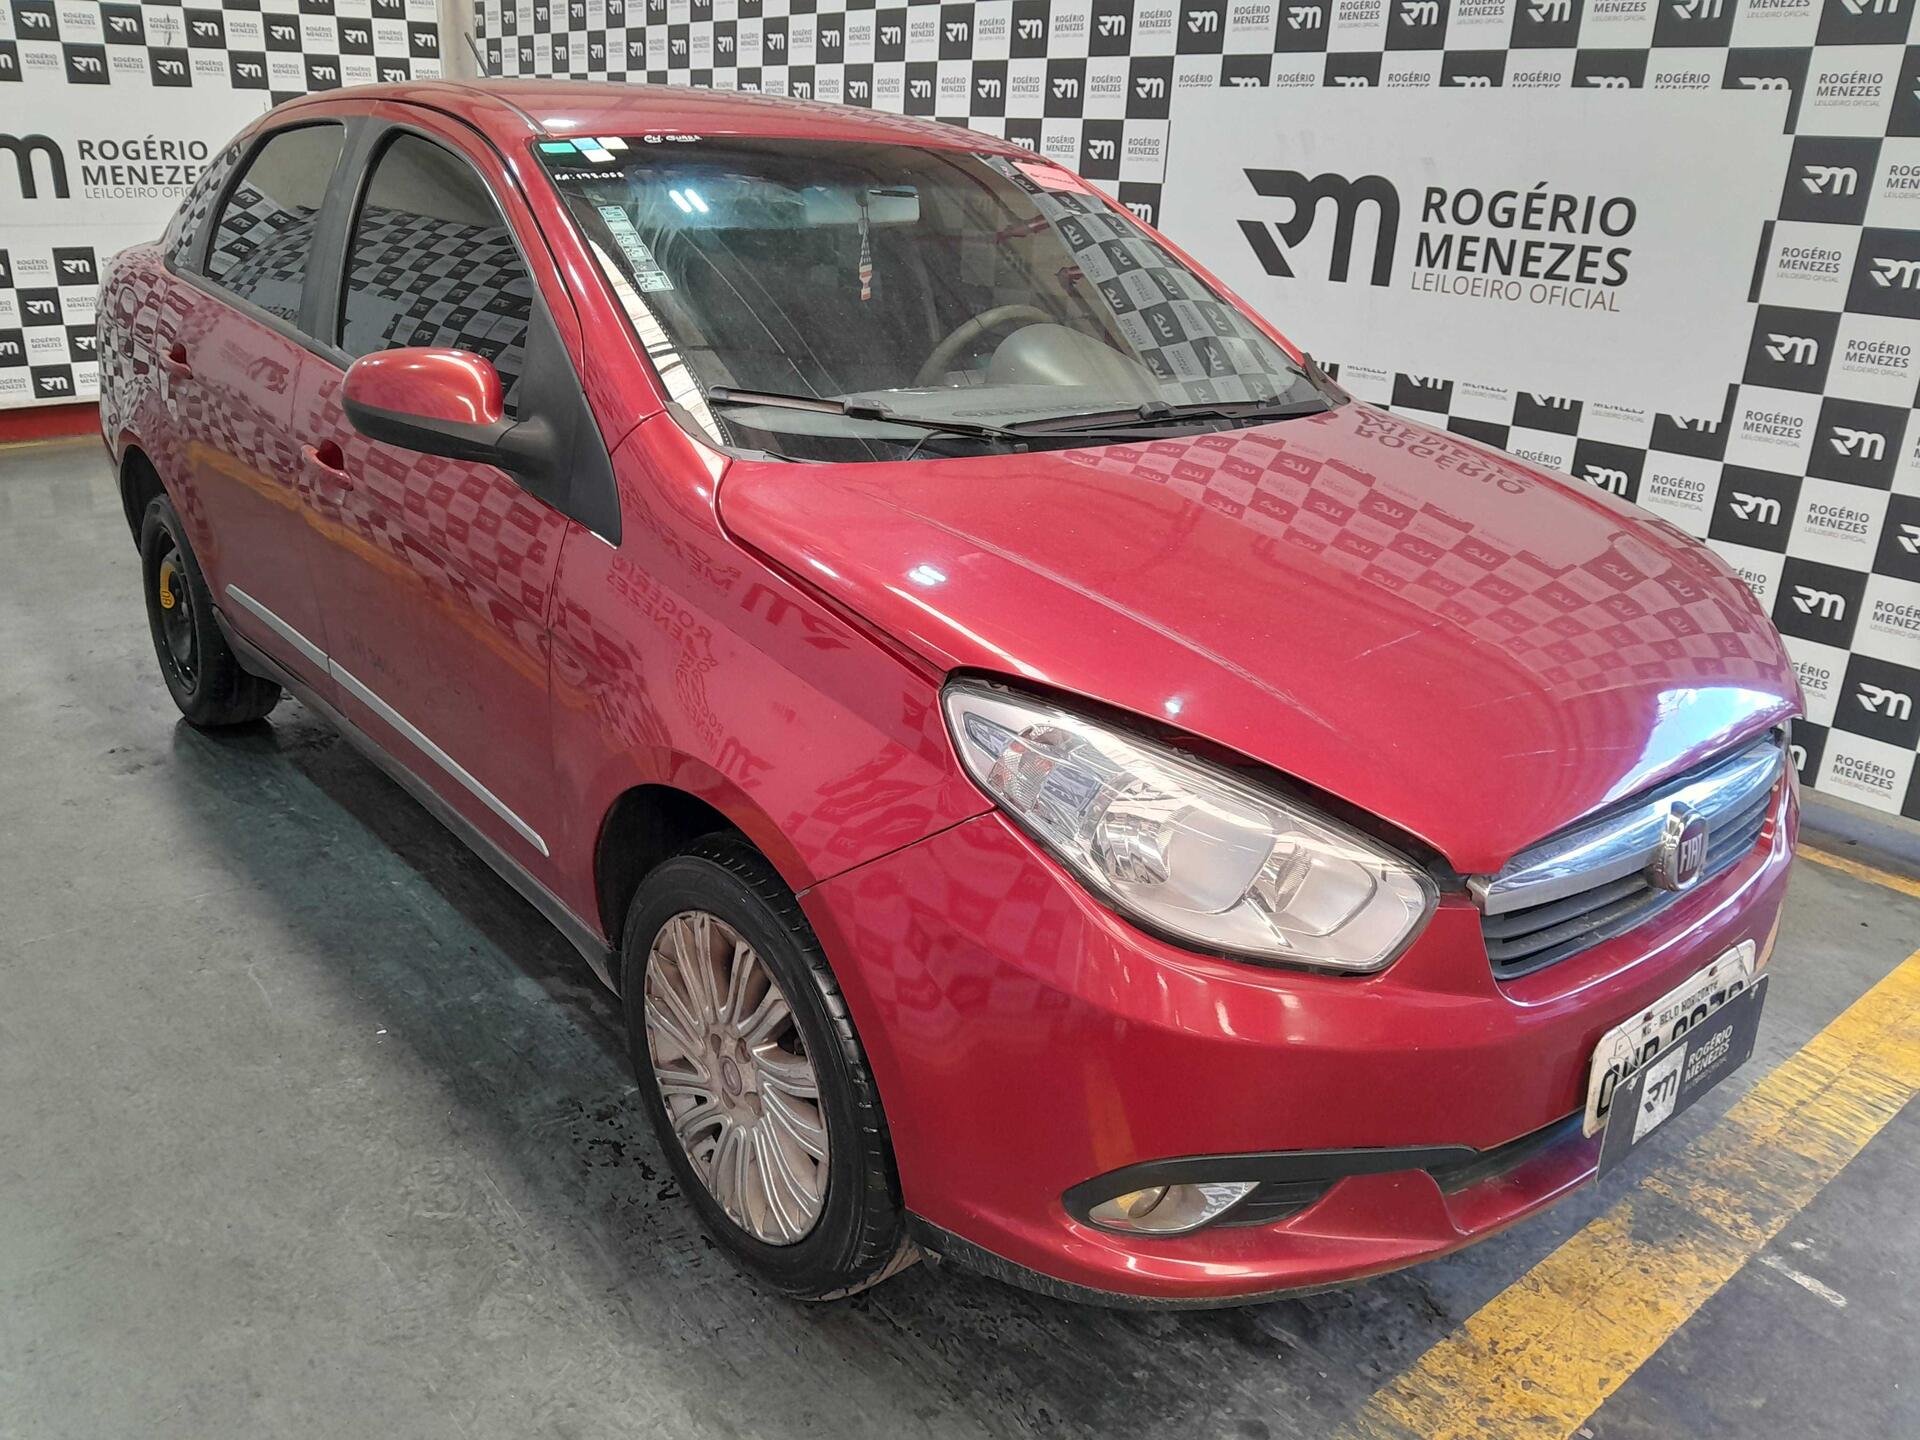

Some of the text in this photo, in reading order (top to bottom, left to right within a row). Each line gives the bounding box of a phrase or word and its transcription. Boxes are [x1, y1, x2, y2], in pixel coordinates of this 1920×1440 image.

[1234, 4, 1271, 16] ROGÉRIO
[1340, 0, 1381, 11] ROGÉRIO
[1458, 6, 1505, 16] MENEZES
[1593, 1, 1647, 13] MENEZES
[1055, 13, 1084, 24] ROGÉRIO
[1139, 9, 1172, 20] ROGÉRIO
[1233, 14, 1270, 25] MENEZES
[1339, 10, 1380, 21] MENEZES
[1054, 23, 1084, 32] MENEZES
[1139, 18, 1172, 28] MENEZES
[1012, 73, 1040, 84] ROGÉRIO
[1091, 73, 1122, 84] ROGÉRIO
[1179, 72, 1213, 83] ROGÉRIO
[1277, 71, 1315, 83] ROGÉRIO
[1388, 71, 1431, 83] ROGÉRIO
[1513, 71, 1562, 83] ROGÉRIO
[1655, 71, 1711, 85] ROGÉRIO
[1819, 70, 1884, 85] ROGÉRIO
[1012, 83, 1040, 93] MENEZES
[1091, 83, 1121, 93] MENEZES
[1816, 85, 1881, 97] MENEZES
[77, 135, 208, 160] ROGÉRIO
[1128, 136, 1160, 147] ROGÉRIO
[1128, 146, 1160, 156] MENEZES
[85, 186, 158, 199] LEILOEIRO
[1421, 181, 1637, 237] ROGÉRIO
[1414, 231, 1632, 287] MENEZES
[1781, 246, 1842, 261] ROGÉRIO
[1779, 259, 1841, 273] MENEZES
[1410, 271, 1621, 313] LEILOEIRO OFICIAL
[1848, 339, 1911, 356] ROGÉRIO
[1845, 352, 1909, 369] MENEZES
[1745, 410, 1803, 428] ROGÉRIO
[1743, 421, 1802, 439] MENEZES
[1652, 474, 1706, 492] ROGÉRIO
[1650, 485, 1704, 503] MENEZES
[1809, 503, 1870, 523] ROGÉRIO
[1806, 514, 1868, 535] MENEZES
[1875, 600, 1920, 619] ROGÉR
[1872, 611, 1920, 631] MENEZ
[1835, 754, 1896, 779] ROGÉRIO
[1832, 764, 1894, 791] MENEZES
[1678, 833, 1703, 875] FIAT
[1687, 1025, 1733, 1067] ROGÉRIO
[1684, 1039, 1730, 1083] MENEZES
